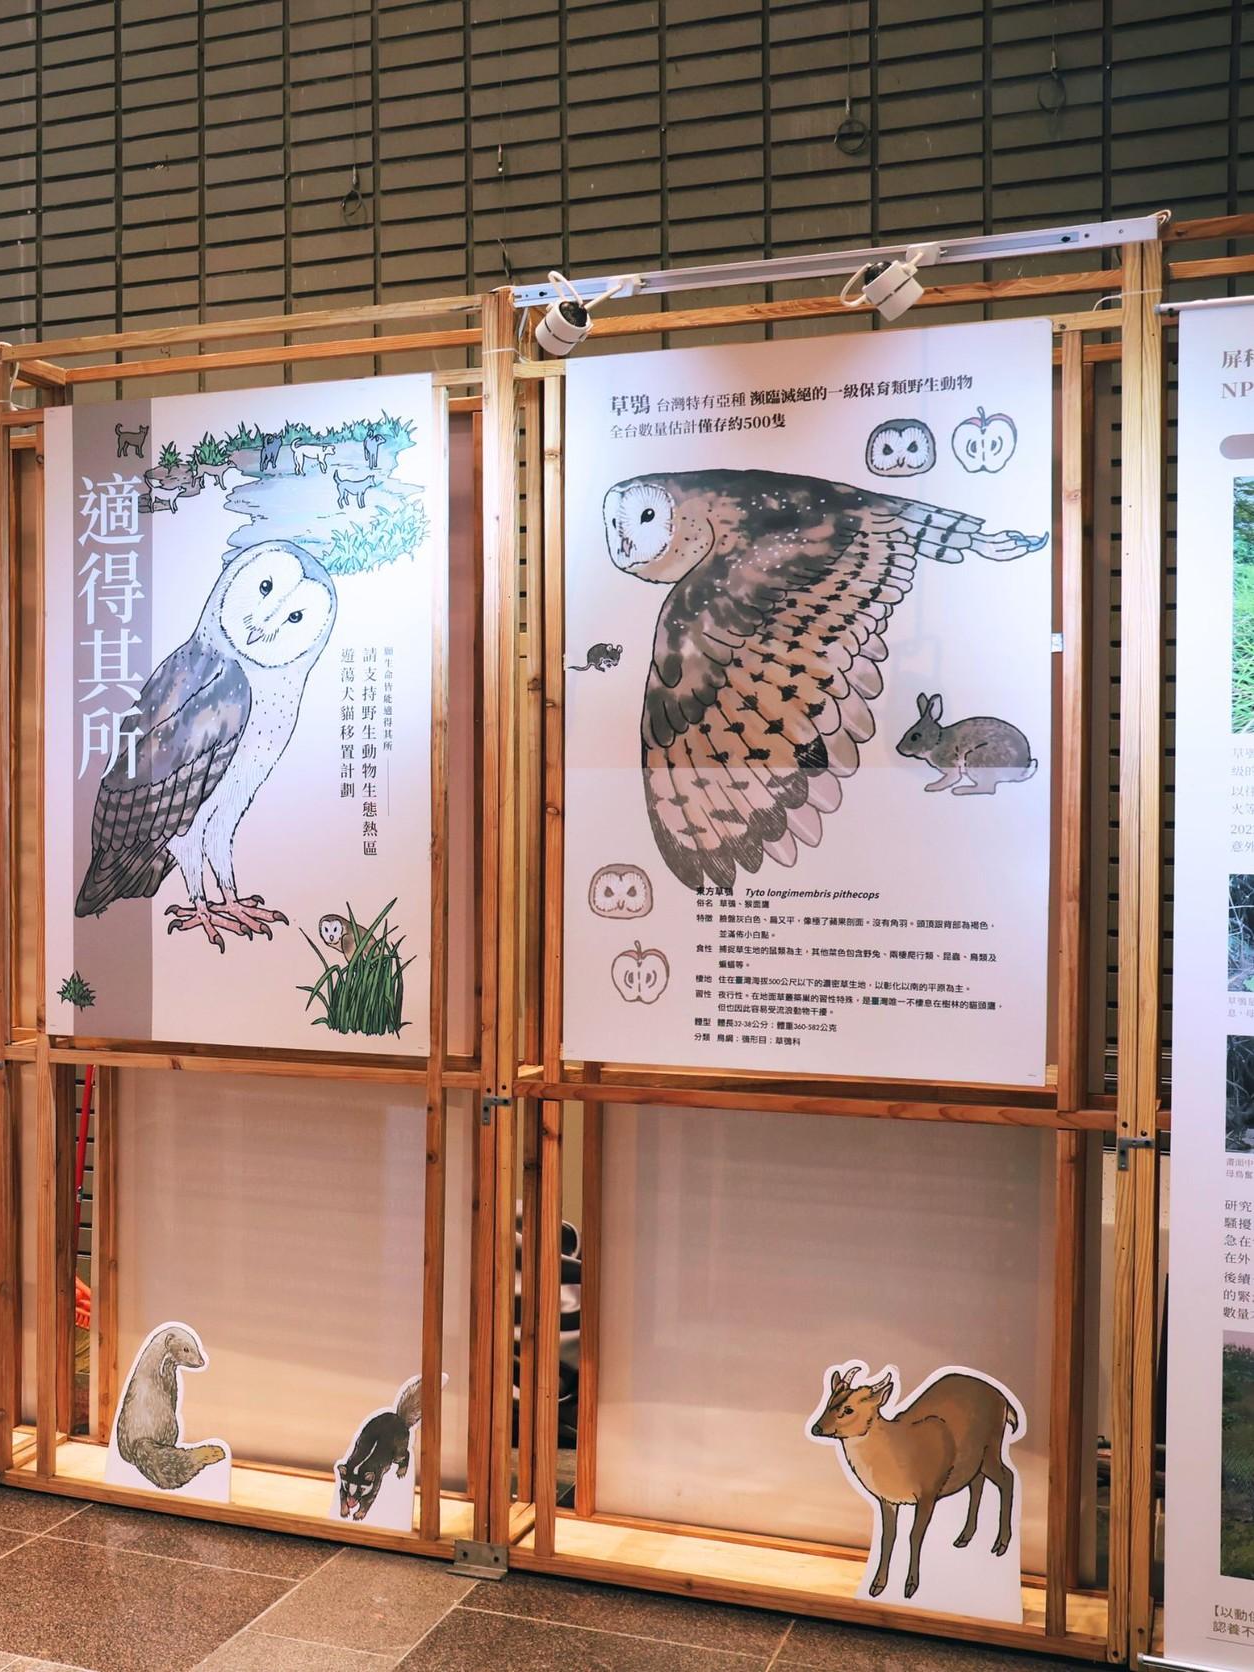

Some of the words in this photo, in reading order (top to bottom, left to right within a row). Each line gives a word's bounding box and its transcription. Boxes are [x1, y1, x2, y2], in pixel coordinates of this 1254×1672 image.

[610, 393, 652, 417] 草鴞
[656, 391, 746, 414] 台灣特有亞種
[749, 374, 974, 406] 瀕臨滅絕的一級保育類野生動物
[610, 414, 786, 439] 全台數量估計僅存約500隻
[77, 472, 145, 780] 適得其所
[361, 647, 378, 856] 請支持野生動物生態熱區
[745, 888, 765, 898] Tyto
[767, 888, 831, 899] longimembris
[832, 889, 880, 900] pithecops
[1224, 1199, 1252, 1213] 研究
[1223, 1306, 1254, 1321] 數量
